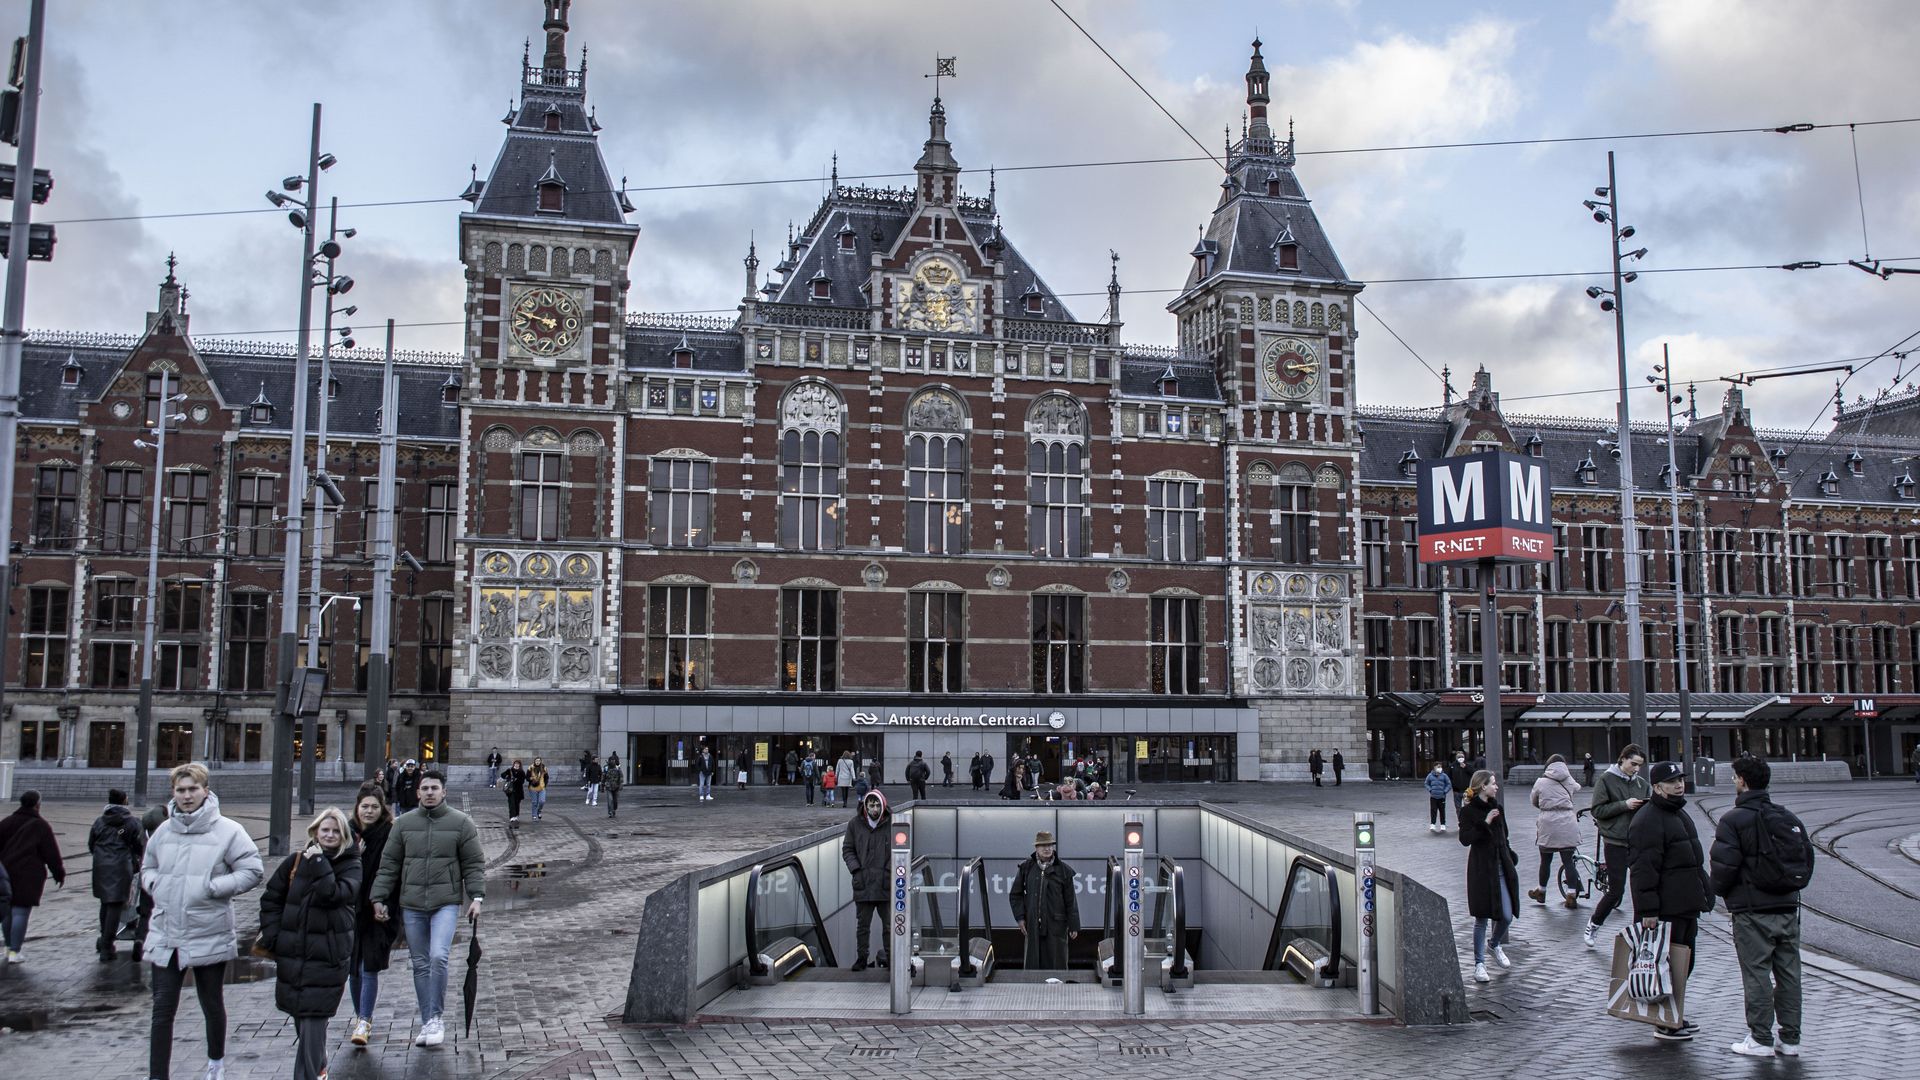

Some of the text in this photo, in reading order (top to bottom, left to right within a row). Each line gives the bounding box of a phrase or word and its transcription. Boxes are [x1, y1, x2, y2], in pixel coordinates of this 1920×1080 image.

[1431, 460, 1485, 525] M
[1509, 460, 1543, 525] M
[888, 712, 1040, 726] Amsterdam Centraal
[1862, 700, 1873, 710] M
